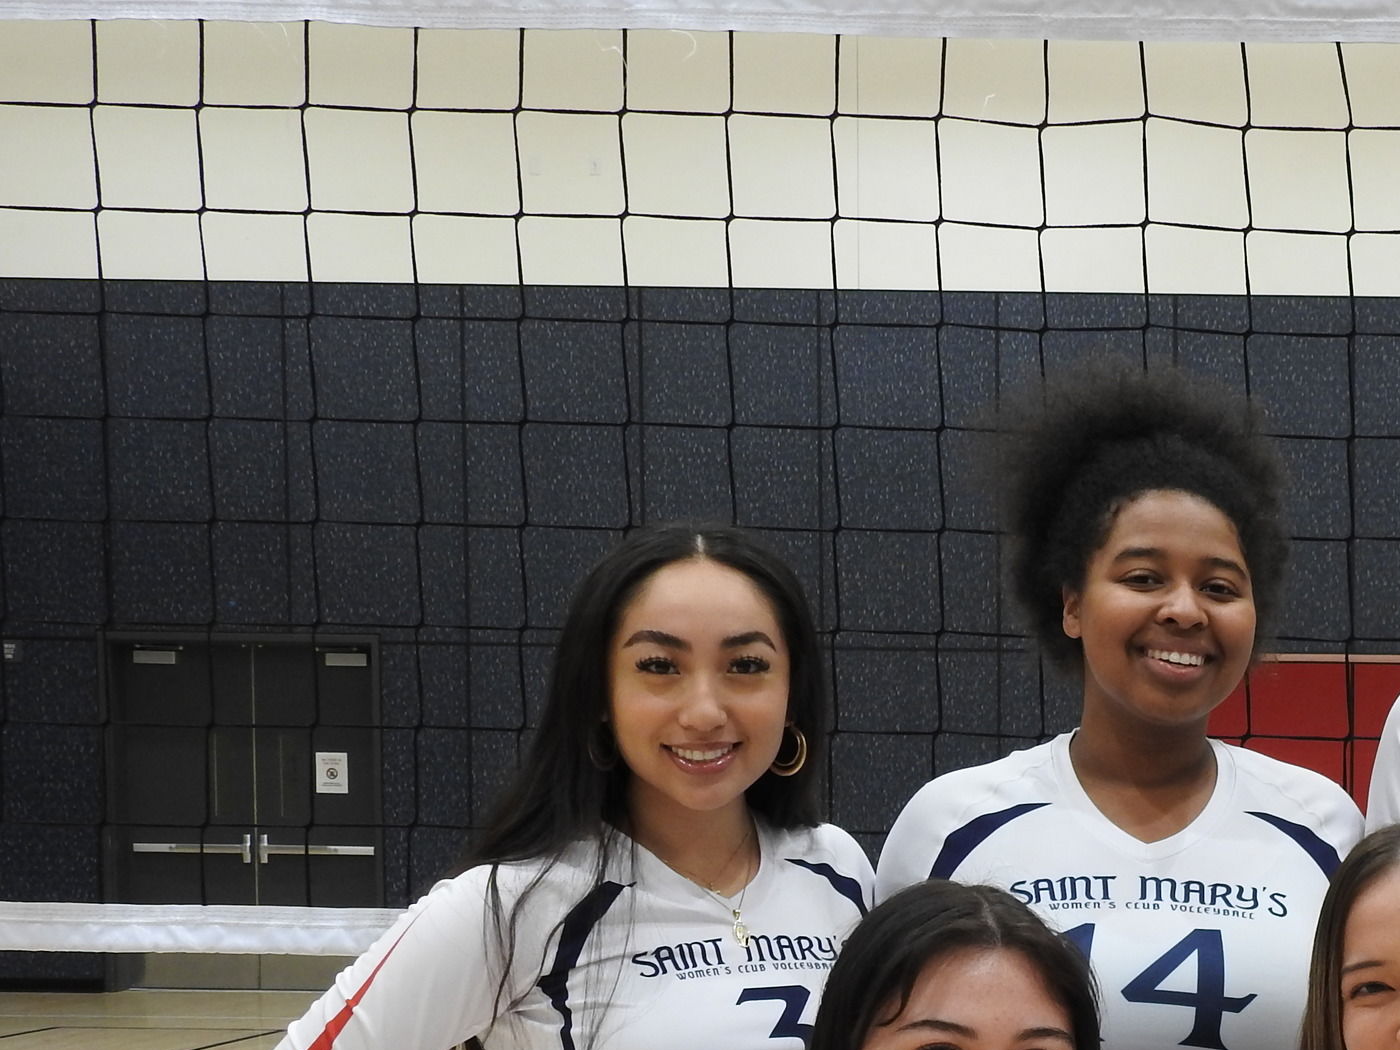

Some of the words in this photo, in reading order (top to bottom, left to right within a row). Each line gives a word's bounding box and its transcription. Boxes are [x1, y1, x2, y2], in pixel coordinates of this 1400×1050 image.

[1009, 875, 1117, 905] SAINT
[1139, 875, 1288, 918] MARY'S
[1049, 901, 1117, 911] WOMEN'S
[1125, 901, 1161, 911] CLUB
[1170, 903, 1255, 920] VOLLEYBALL
[631, 937, 726, 978] SAINT
[745, 934, 839, 962] MARY'
[676, 965, 732, 981] WOMEN'S
[738, 962, 767, 974] CLUB
